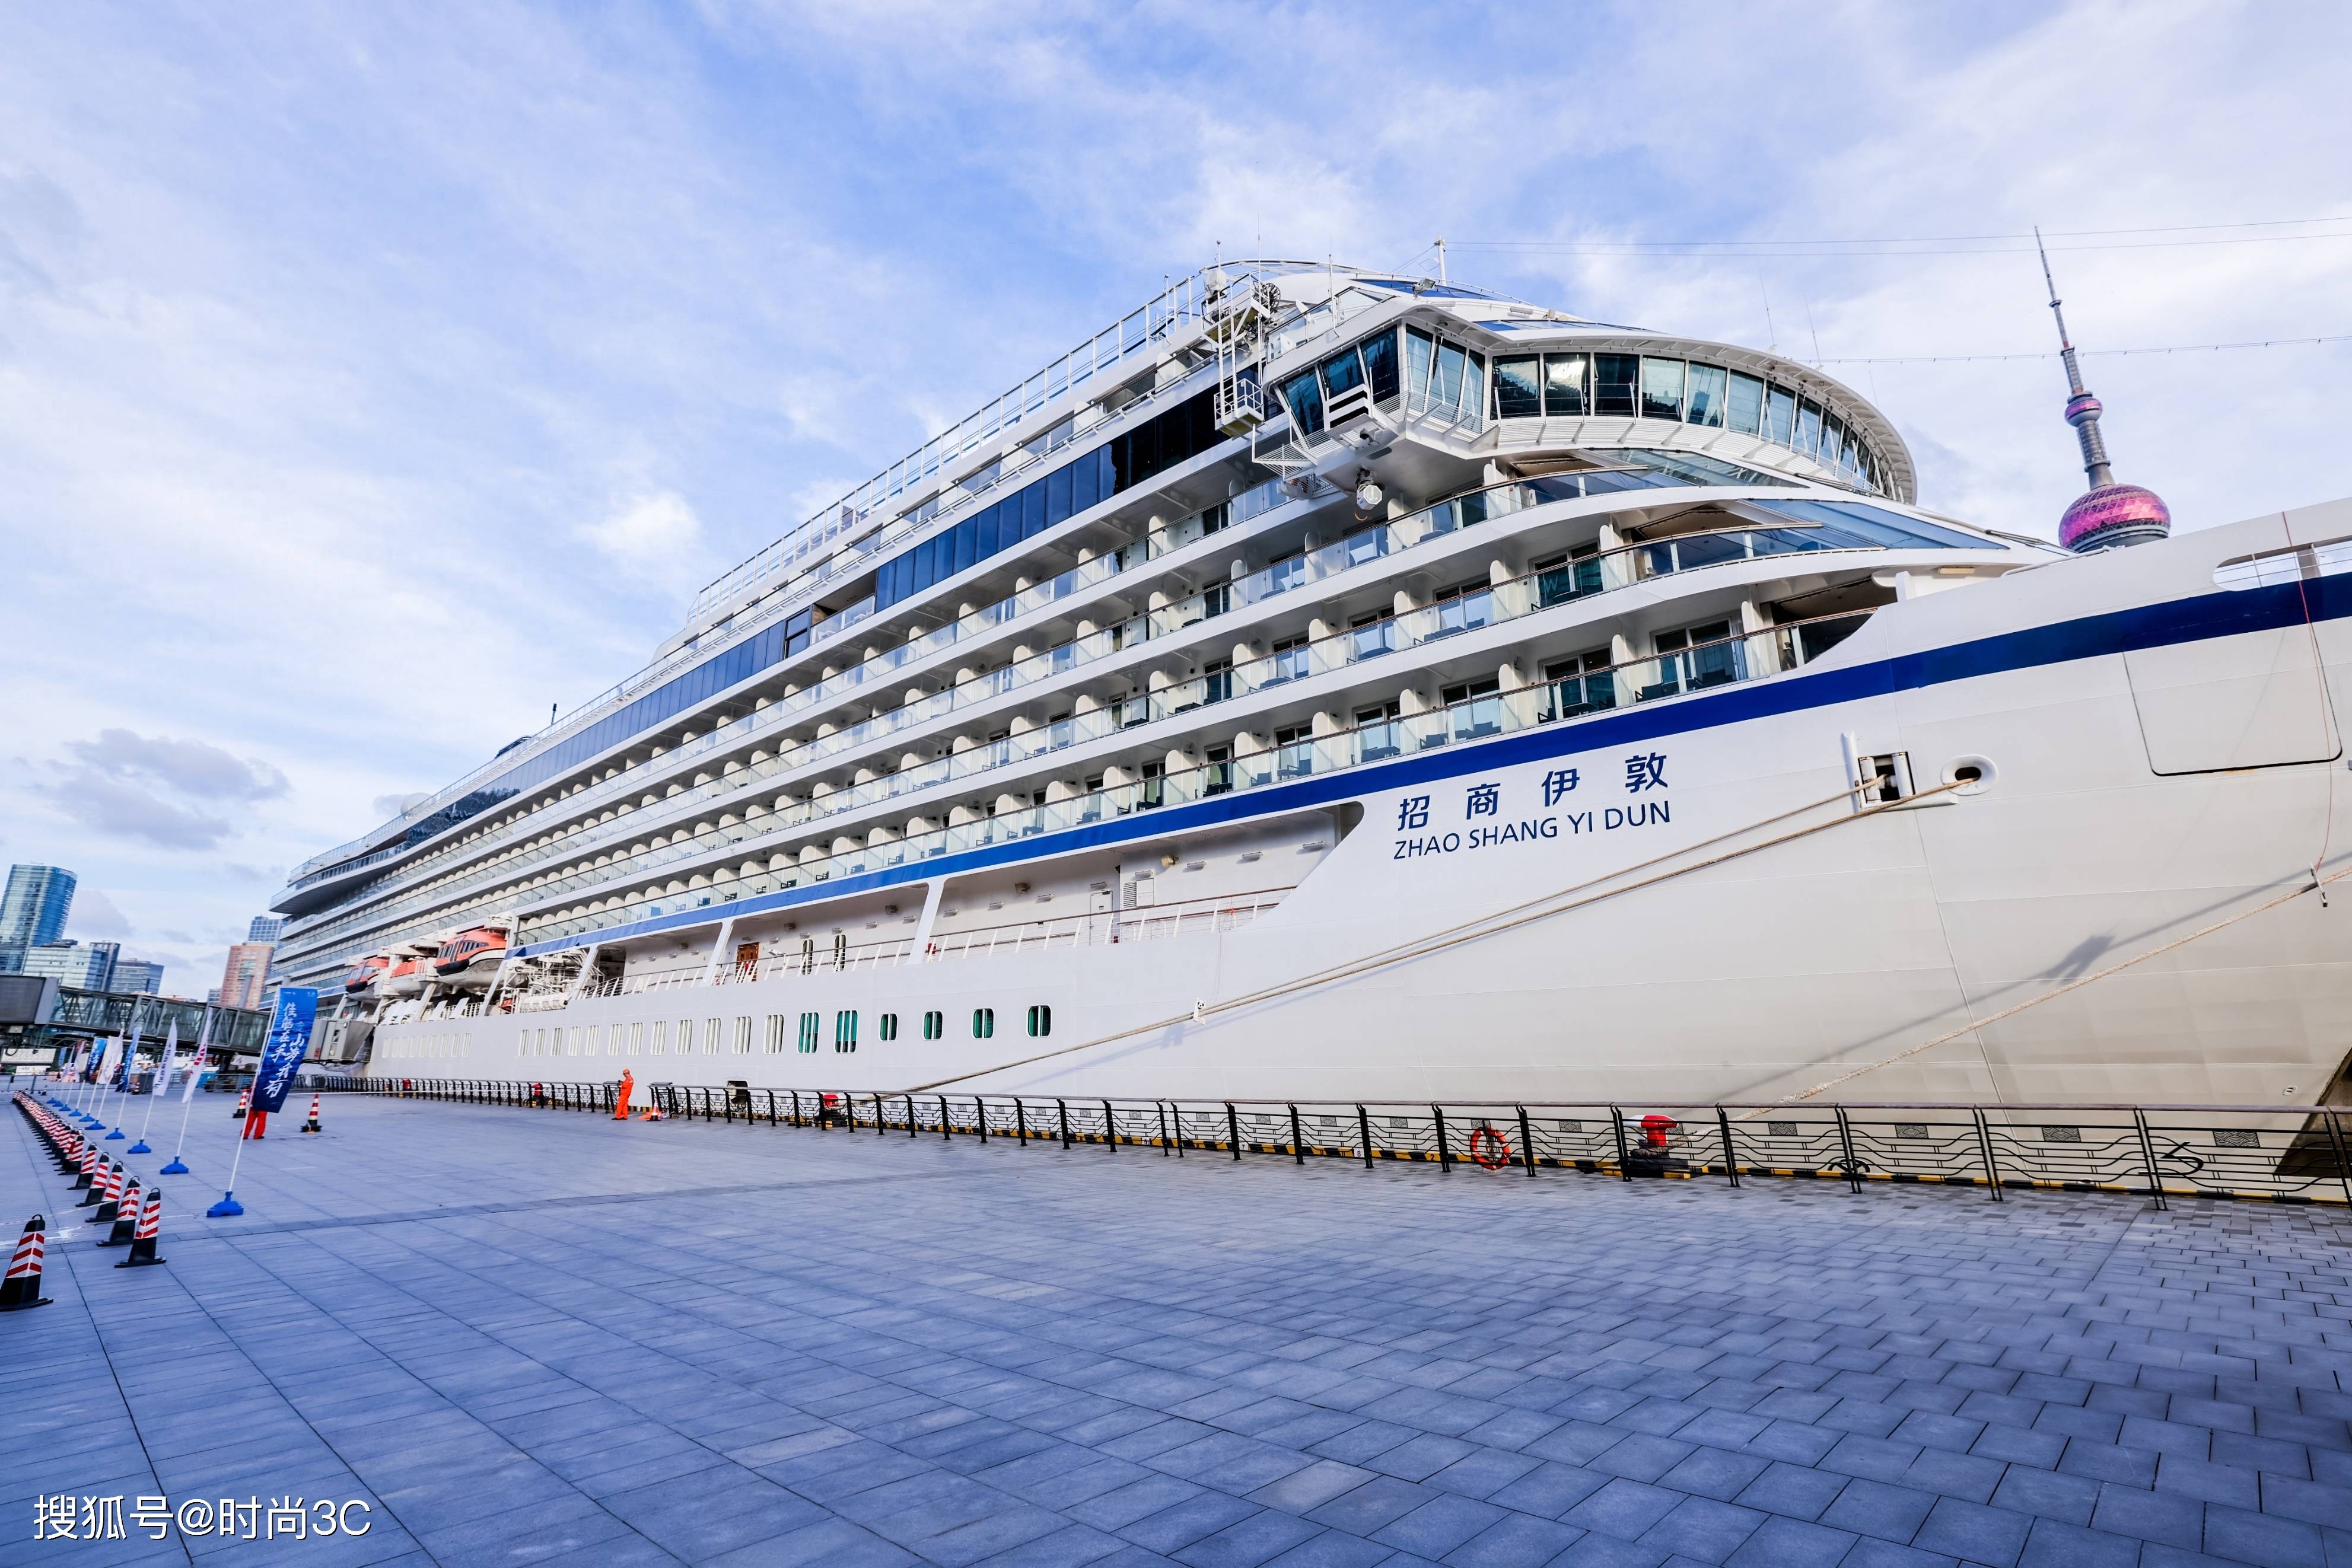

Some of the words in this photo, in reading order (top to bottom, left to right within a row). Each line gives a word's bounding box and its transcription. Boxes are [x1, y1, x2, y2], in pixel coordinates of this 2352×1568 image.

[1398, 752, 1667, 831] 招商伊敦
[1394, 833, 1460, 859] ZHAO
[1469, 817, 1557, 849] SHANG
[1567, 811, 1592, 834] YI
[1605, 801, 1670, 830] DUN
